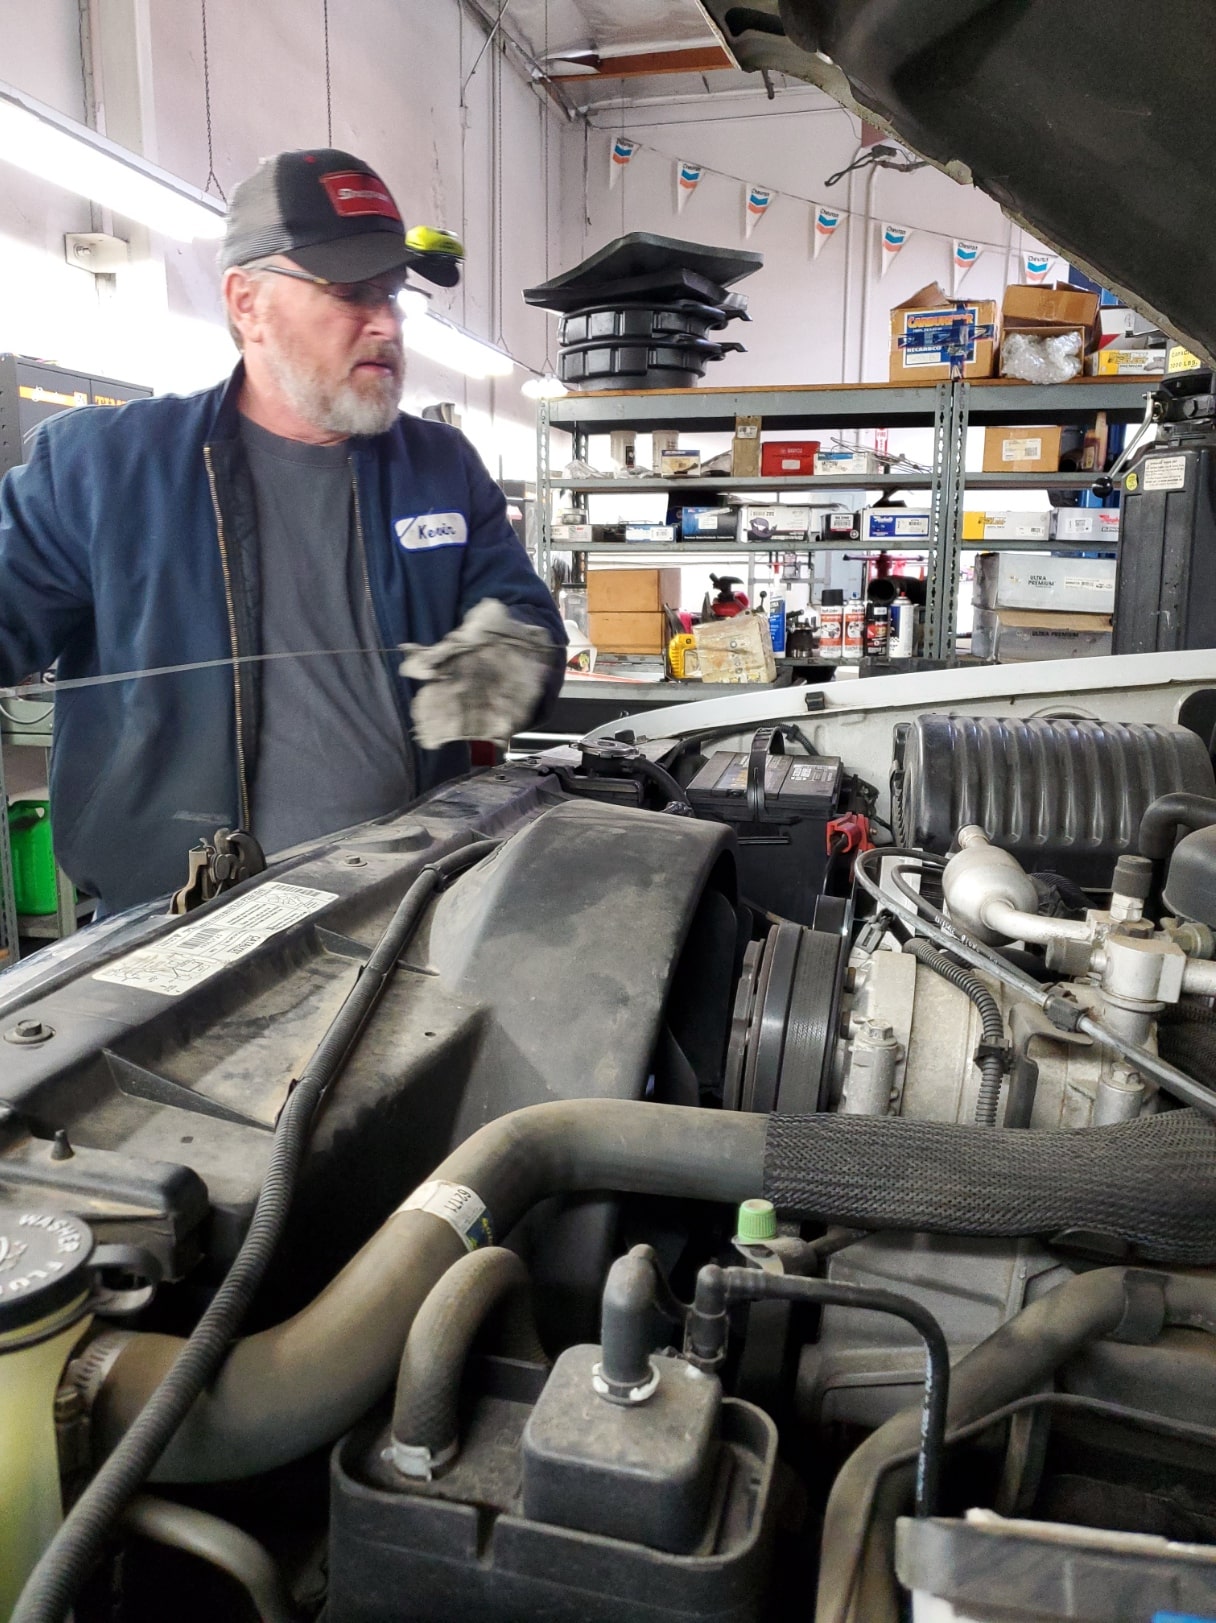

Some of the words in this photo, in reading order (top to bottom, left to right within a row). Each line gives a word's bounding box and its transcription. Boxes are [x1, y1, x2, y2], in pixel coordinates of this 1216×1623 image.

[751, 188, 770, 197] Chevron
[819, 208, 840, 218] Chevron
[886, 226, 906, 235] Chevron
[958, 242, 978, 251] Chevron
[1028, 255, 1049, 263] Chevron
[417, 522, 457, 540] Kevin
[1031, 630, 1050, 638] ULTRA
[19, 1214, 81, 1254] WASHER
